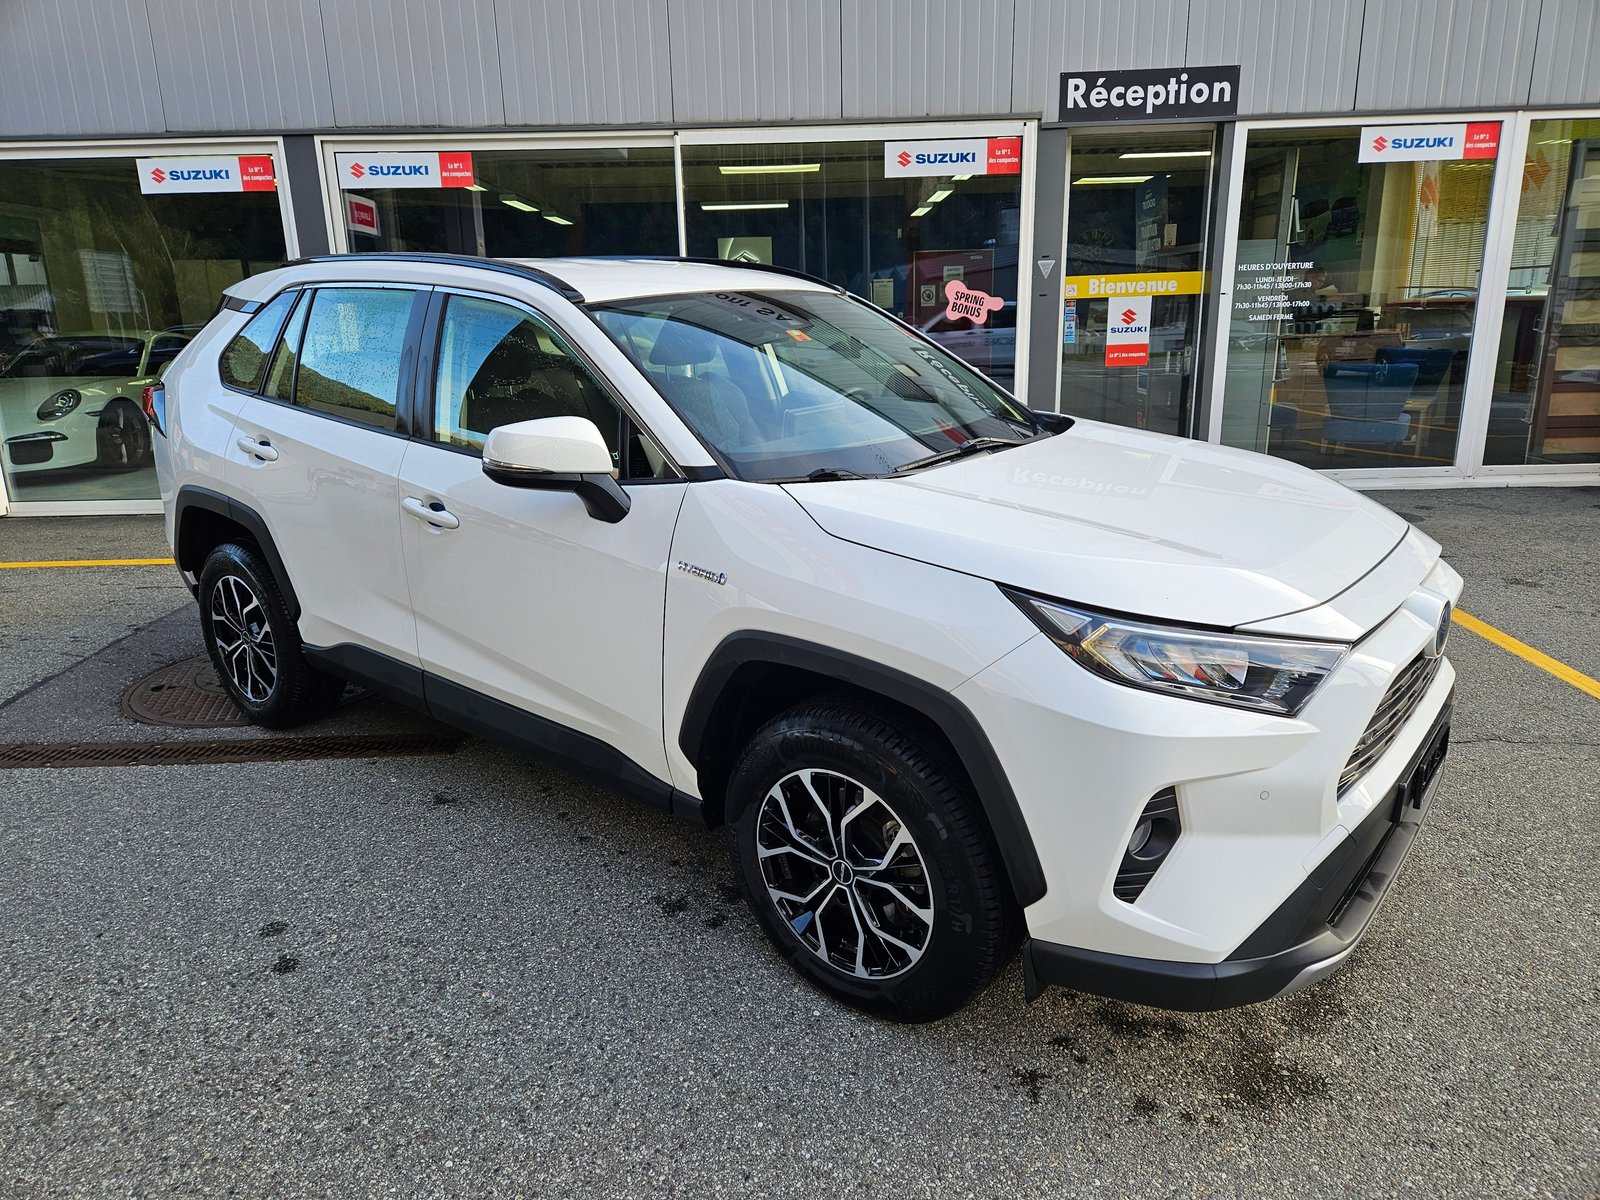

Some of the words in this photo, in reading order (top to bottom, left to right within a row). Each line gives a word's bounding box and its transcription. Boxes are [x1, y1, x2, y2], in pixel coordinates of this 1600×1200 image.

[1066, 73, 1231, 114] Réception
[1391, 137, 1454, 149] SUZUKI
[915, 152, 976, 164] SUZUKI
[168, 169, 230, 181] SUZUKI
[368, 165, 429, 176] SUZUKI
[1238, 263, 1265, 271] HEURES
[1265, 262, 1314, 270] D'OUVERTURE
[1088, 277, 1178, 295] Bienvenue
[954, 290, 985, 307] SPRING
[951, 301, 982, 318] BONUS
[1110, 326, 1148, 334] SUZUKI
